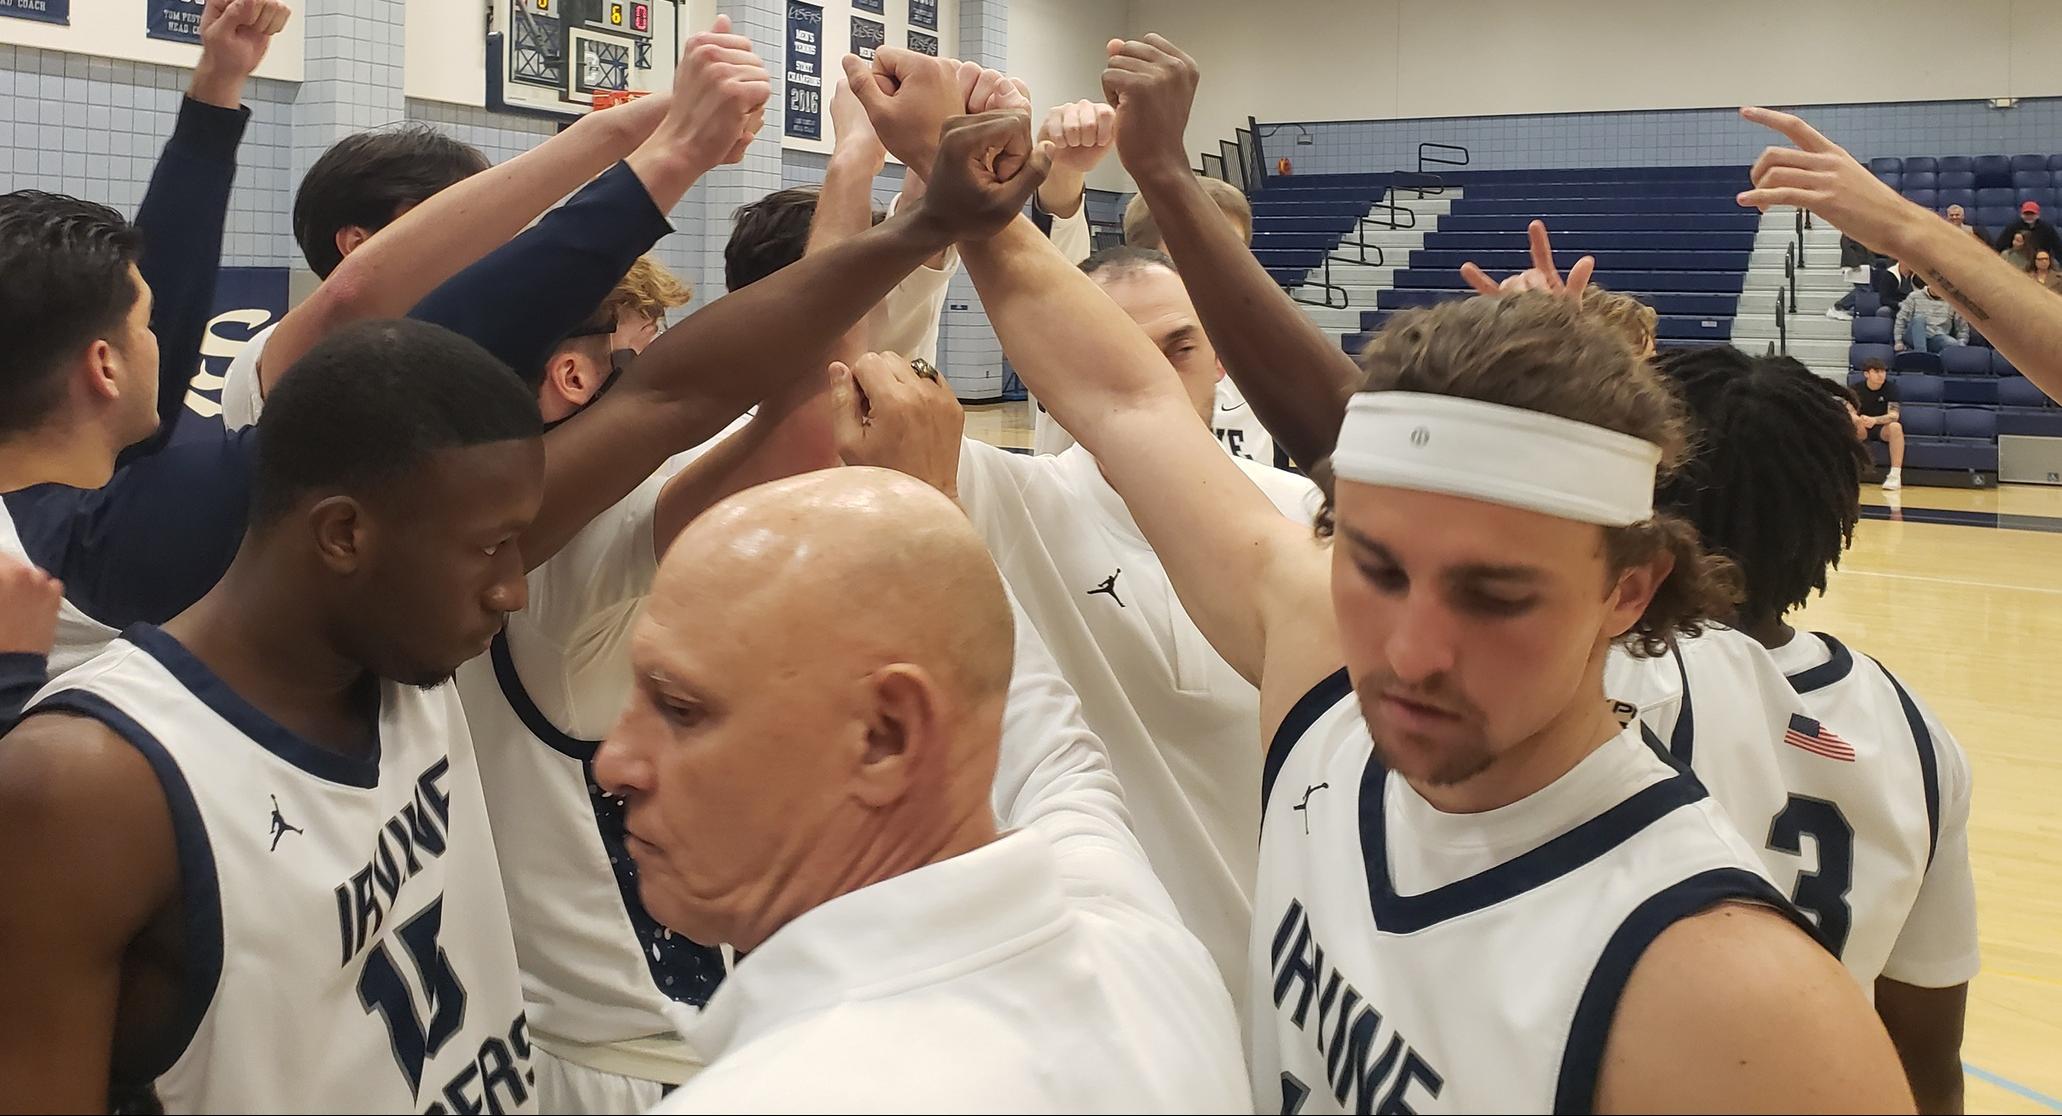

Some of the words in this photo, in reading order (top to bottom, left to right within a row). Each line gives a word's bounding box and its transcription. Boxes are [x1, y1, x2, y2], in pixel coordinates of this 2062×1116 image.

[17, 0, 47, 12] COACH
[163, 9, 181, 21] TOM
[611, 5, 622, 24] 6
[168, 21, 190, 34] HEAD
[790, 87, 819, 114] 2016
